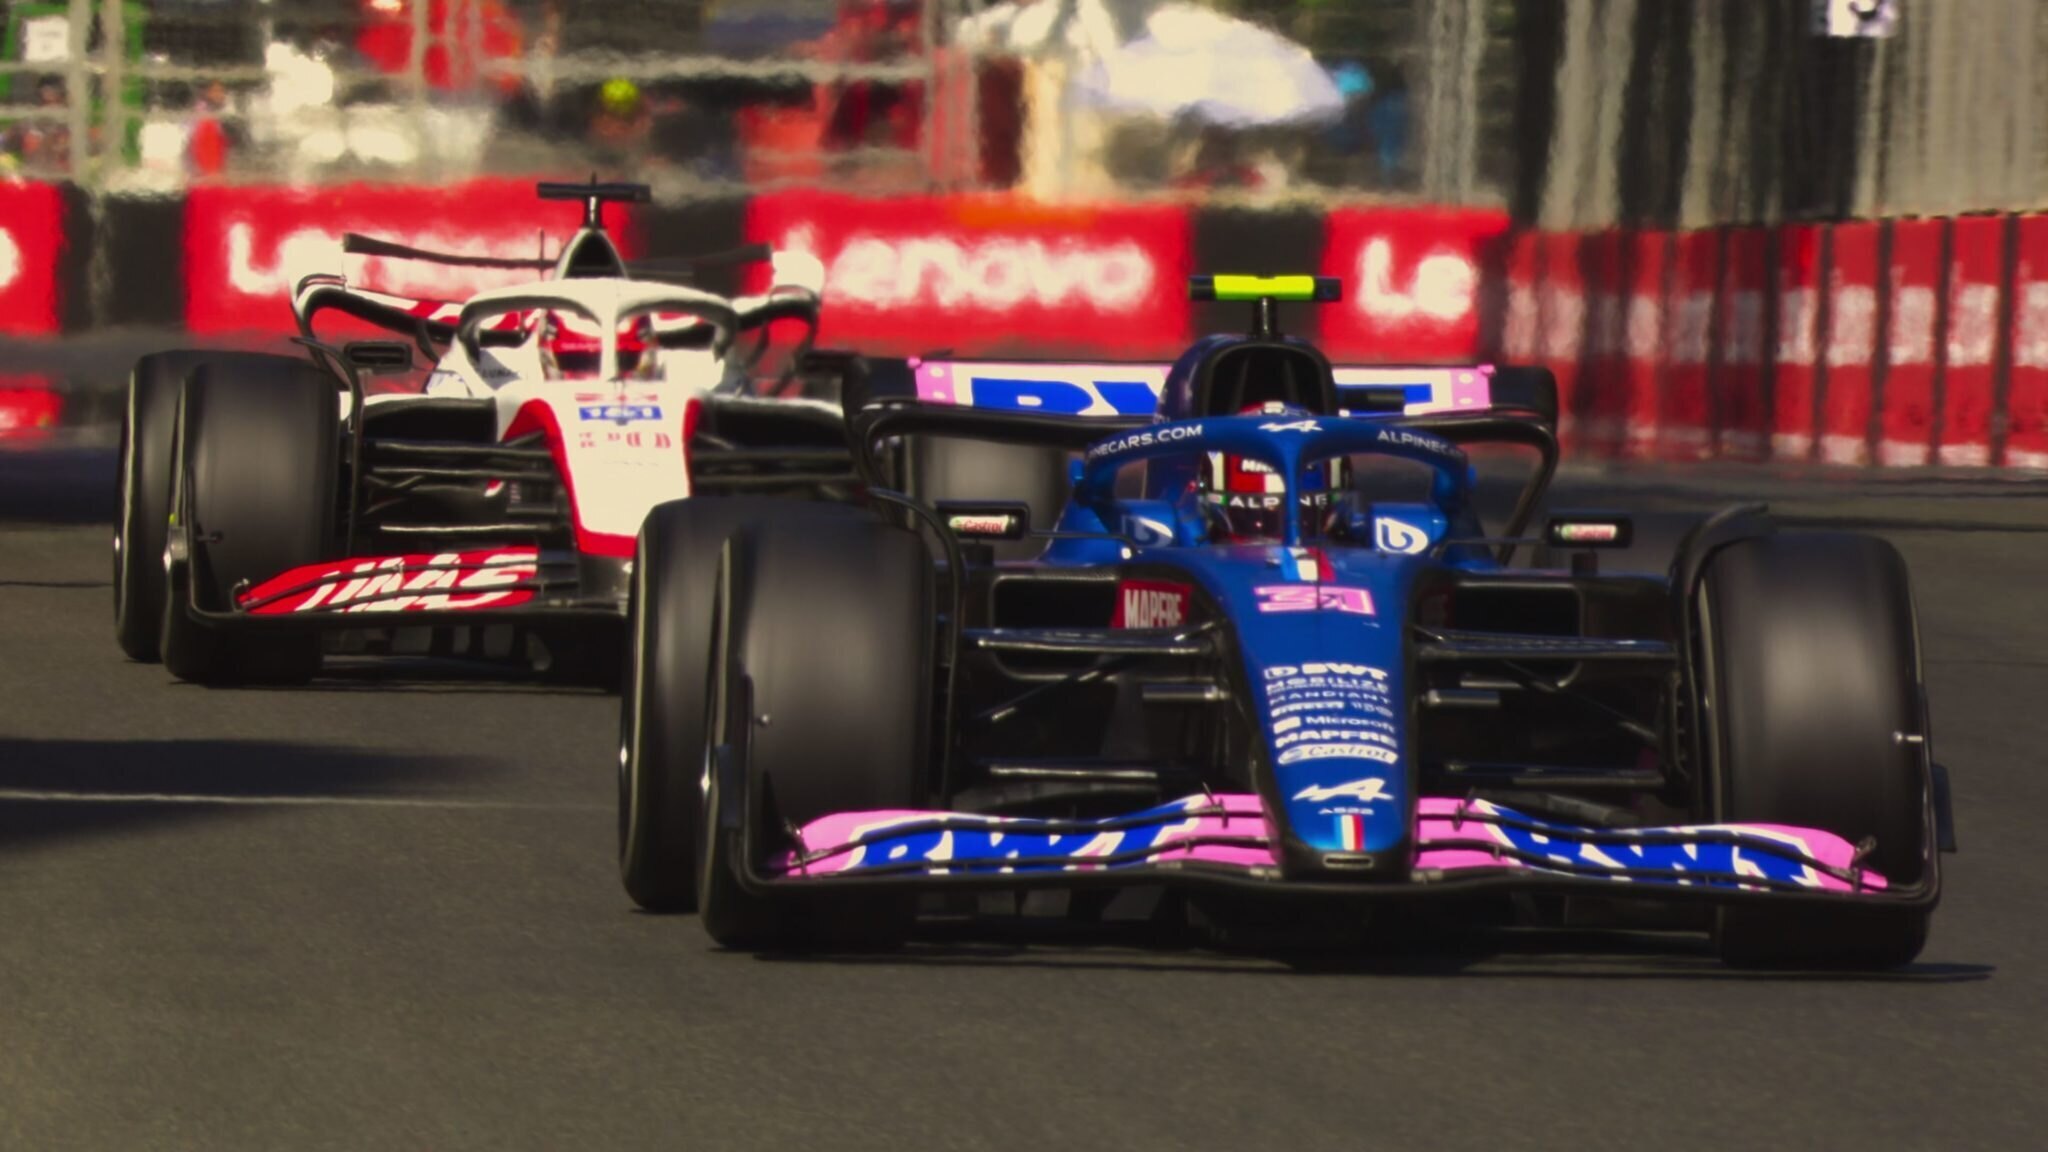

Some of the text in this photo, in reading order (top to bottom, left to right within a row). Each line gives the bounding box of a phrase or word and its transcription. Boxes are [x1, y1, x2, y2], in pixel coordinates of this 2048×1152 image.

[1090, 424, 1203, 458] NECARS.COM
[1230, 493, 1328, 509] ALPNE
[1124, 589, 1182, 629] MAPFRE
[1254, 585, 1375, 616] 31
[1266, 677, 1389, 695] MOBILIZE
[1270, 691, 1391, 706] MANDIANT
[1275, 730, 1397, 748] MAPFRE
